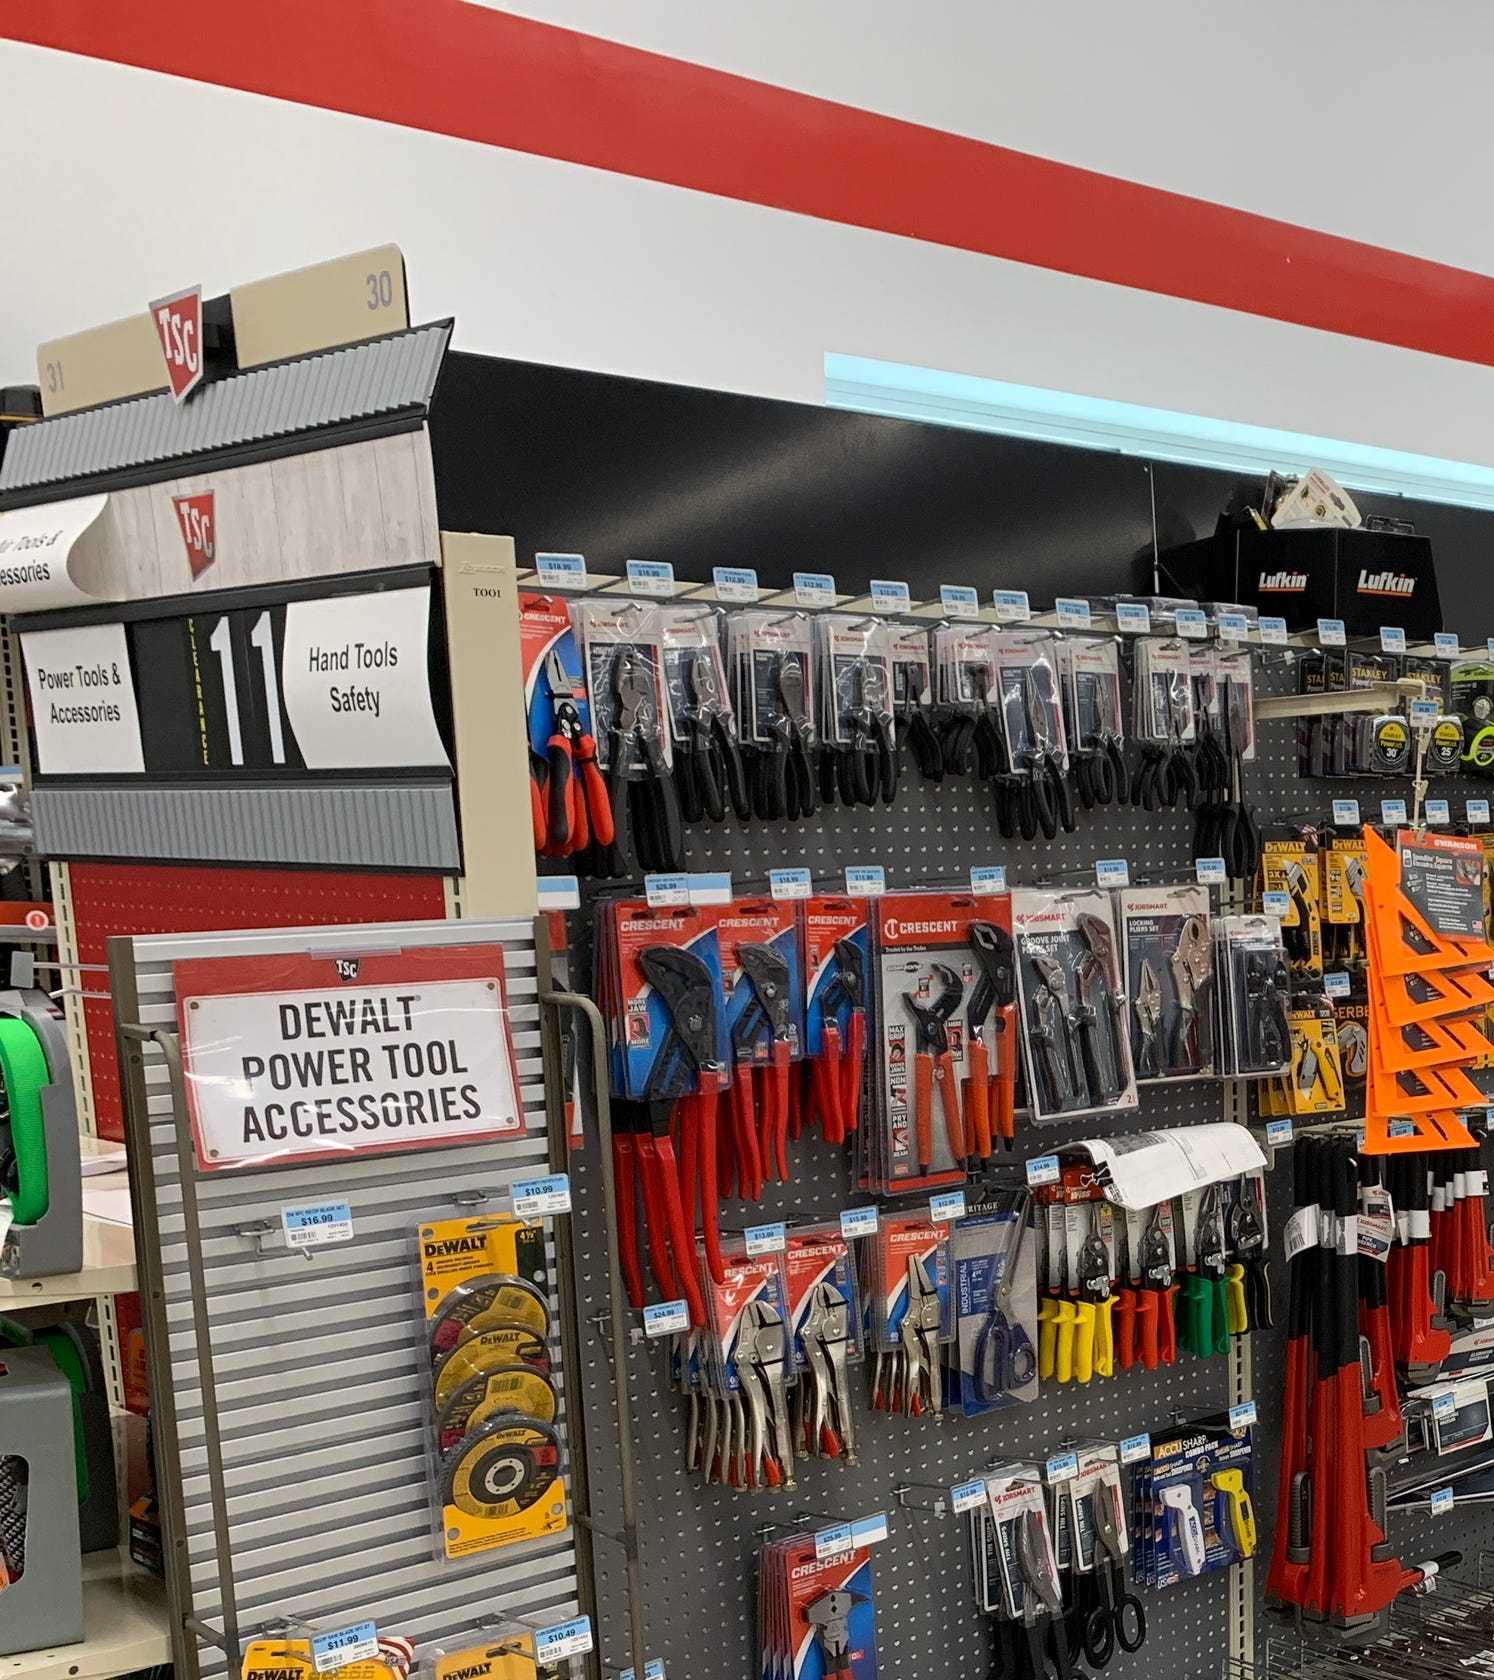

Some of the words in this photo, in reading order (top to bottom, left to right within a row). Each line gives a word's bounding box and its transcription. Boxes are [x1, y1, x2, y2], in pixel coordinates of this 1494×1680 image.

[366, 270, 392, 310] 30
[157, 306, 198, 373] TSC
[48, 362, 64, 394] 31
[180, 501, 215, 558] TSC
[0, 558, 51, 586] essories
[1259, 571, 1308, 588] Lufkin
[1357, 569, 1416, 593] Lufkin
[524, 612, 567, 624] CRESCENT
[308, 643, 350, 673] Hand
[354, 641, 399, 671] Tools
[38, 666, 74, 691] Power
[75, 663, 110, 688] Tools
[111, 662, 121, 686] &
[1351, 667, 1389, 680] STANLEY
[1407, 671, 1442, 684] STANLEY
[187, 617, 209, 767] CLEARANCE
[209, 610, 286, 767] 11
[329, 686, 381, 718] Safety
[50, 700, 121, 725] Accessories
[620, 917, 685, 932] CRESCENT
[718, 917, 779, 928] CRESCENT
[808, 915, 858, 926] CRESCENT
[900, 921, 958, 934] CRESCENT
[335, 959, 359, 979] TSC
[279, 995, 417, 1041] DEWALT
[242, 1045, 371, 1092] POWER
[381, 1039, 469, 1081] TOOL
[242, 1083, 482, 1144] ACCESSORIES
[525, 1185, 553, 1197] $10.99
[968, 1201, 999, 1214] RITAGE
[301, 1213, 333, 1227] $16.99
[424, 1234, 487, 1258] DEWALT
[890, 1229, 947, 1243] CRESCENT
[788, 1243, 844, 1260] CRESCENT
[723, 1262, 775, 1279] RESCENT
[959, 1262, 970, 1314] INDUSTRIAL
[480, 1332, 521, 1346] DEWALT
[1158, 1441, 1183, 1459] ACCU
[1183, 1434, 1207, 1451] SHARP
[1002, 1486, 1036, 1503] JOBSMART
[791, 1550, 856, 1580] CRESCENT
[327, 1634, 359, 1650] $11.99
[547, 1628, 576, 1643] $10.49
[442, 1662, 492, 1680] DEWALT
